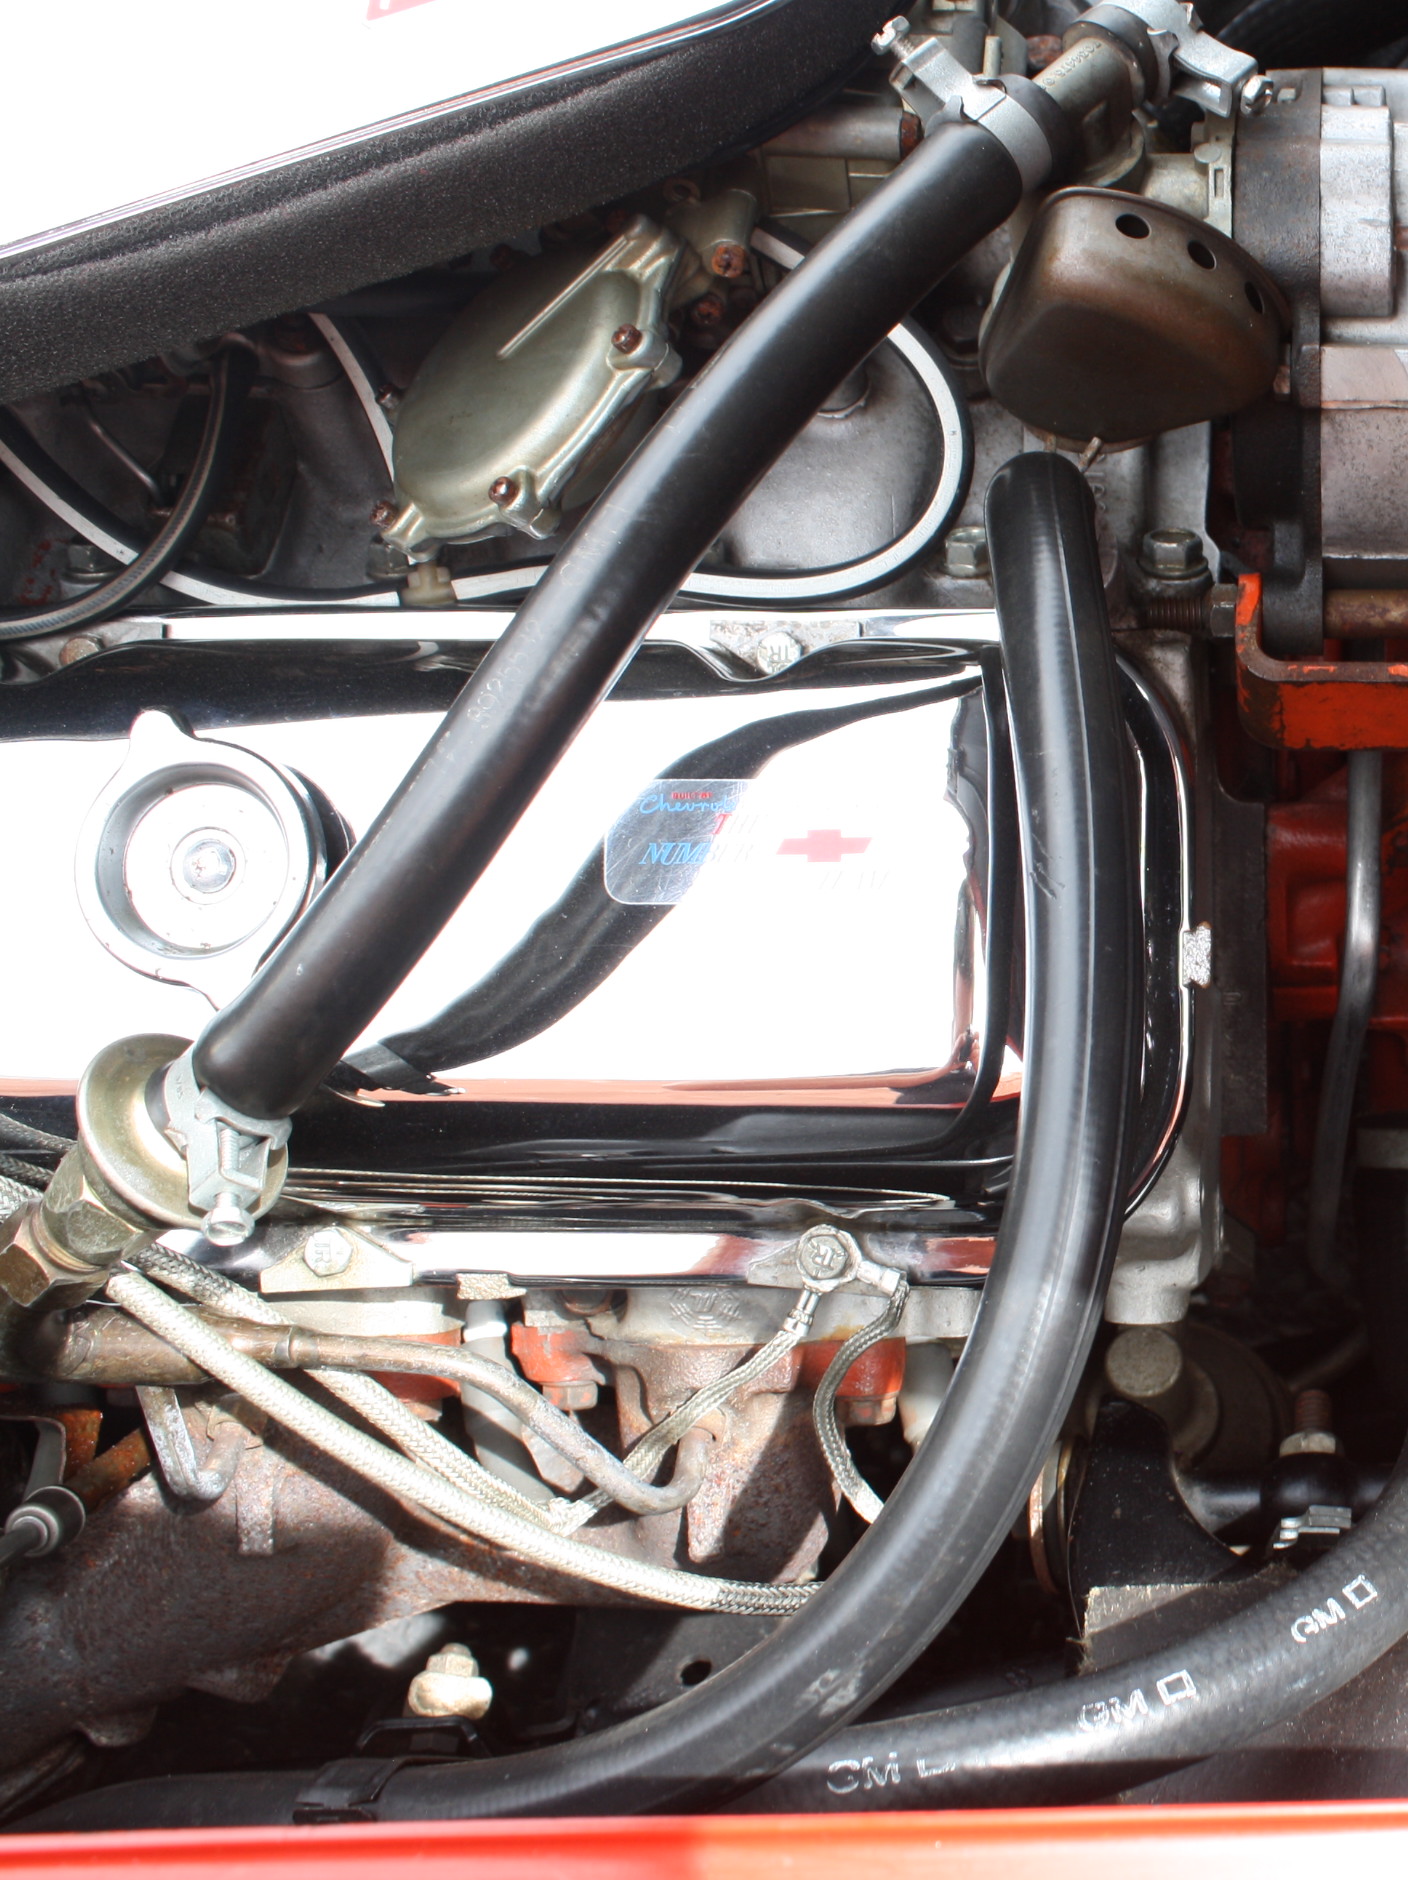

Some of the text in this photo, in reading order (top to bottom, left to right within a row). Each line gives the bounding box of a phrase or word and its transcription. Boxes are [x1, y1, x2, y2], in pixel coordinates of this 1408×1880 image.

[1291, 1597, 1346, 1643] GM
[1078, 1688, 1149, 1732] GM
[827, 1753, 901, 1794] GM
